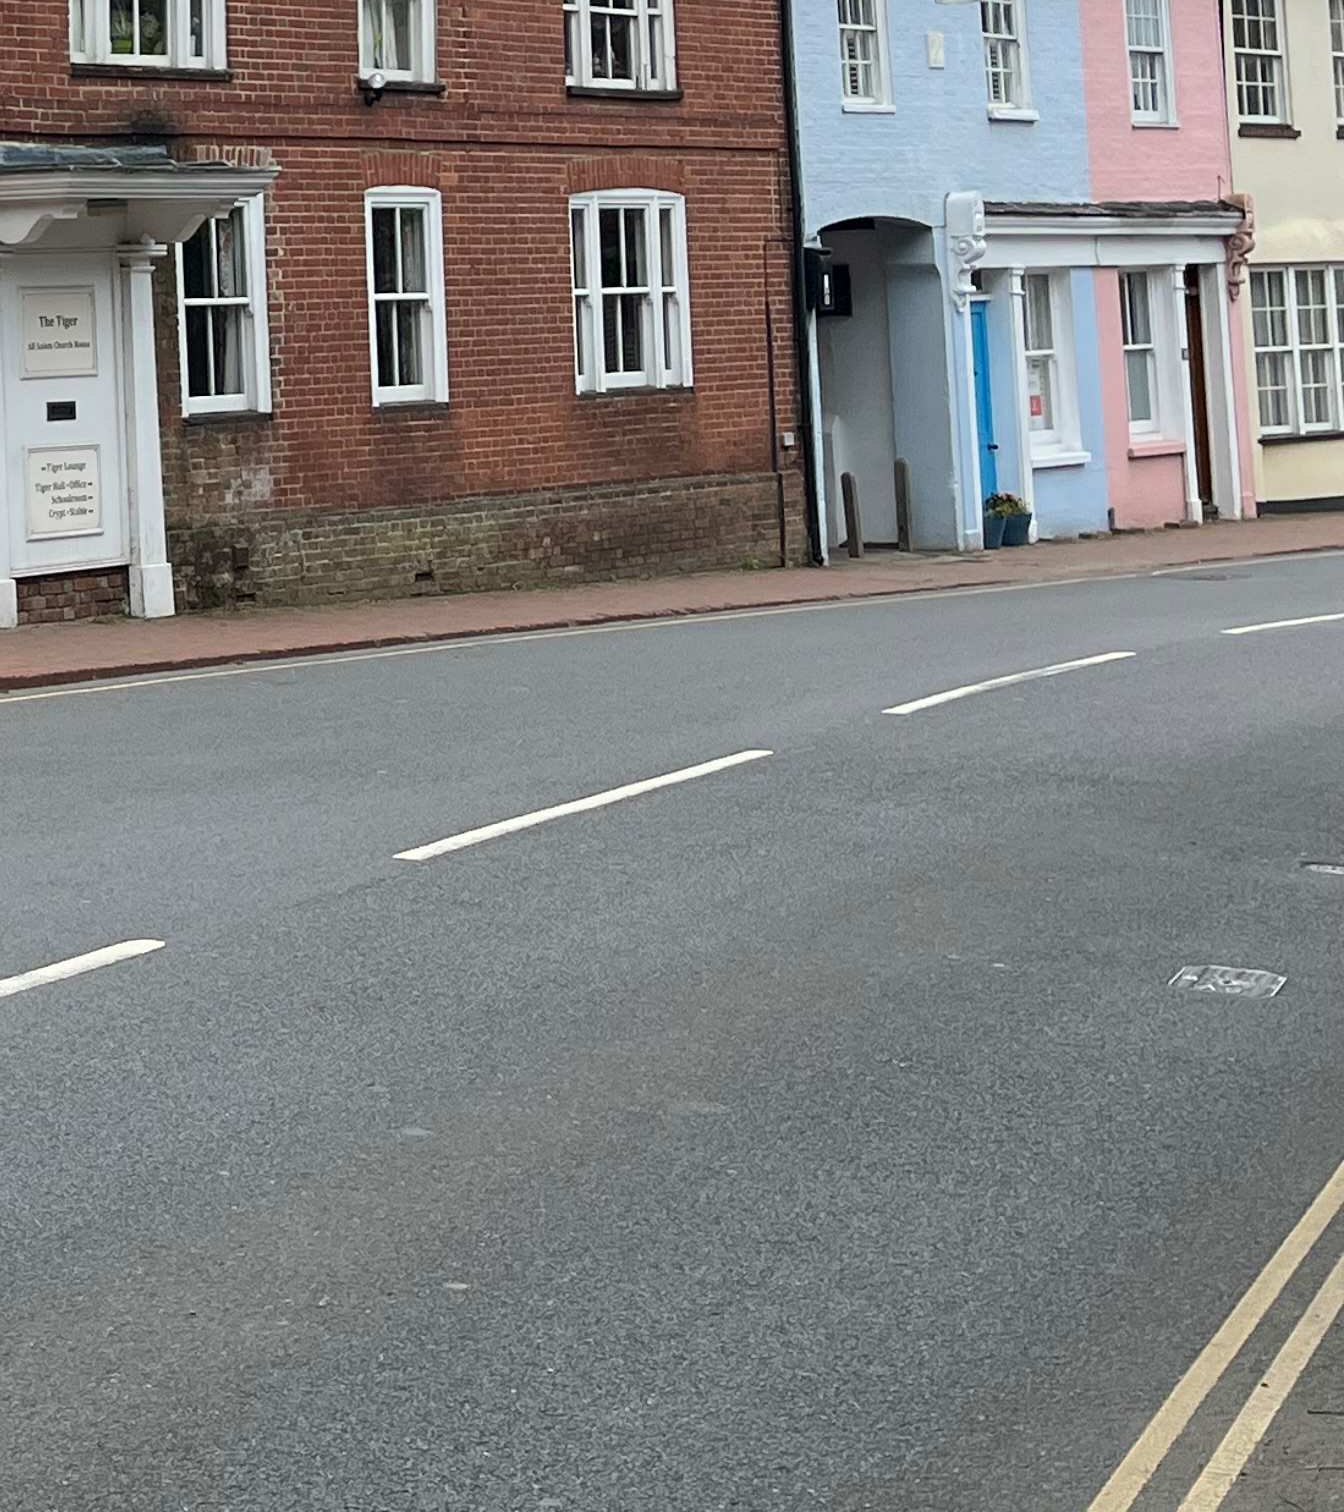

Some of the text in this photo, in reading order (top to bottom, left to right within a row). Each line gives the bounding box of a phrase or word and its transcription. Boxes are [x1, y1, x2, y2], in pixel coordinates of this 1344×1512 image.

[38, 314, 79, 330] The Tiger
[46, 462, 63, 474] Tiger
